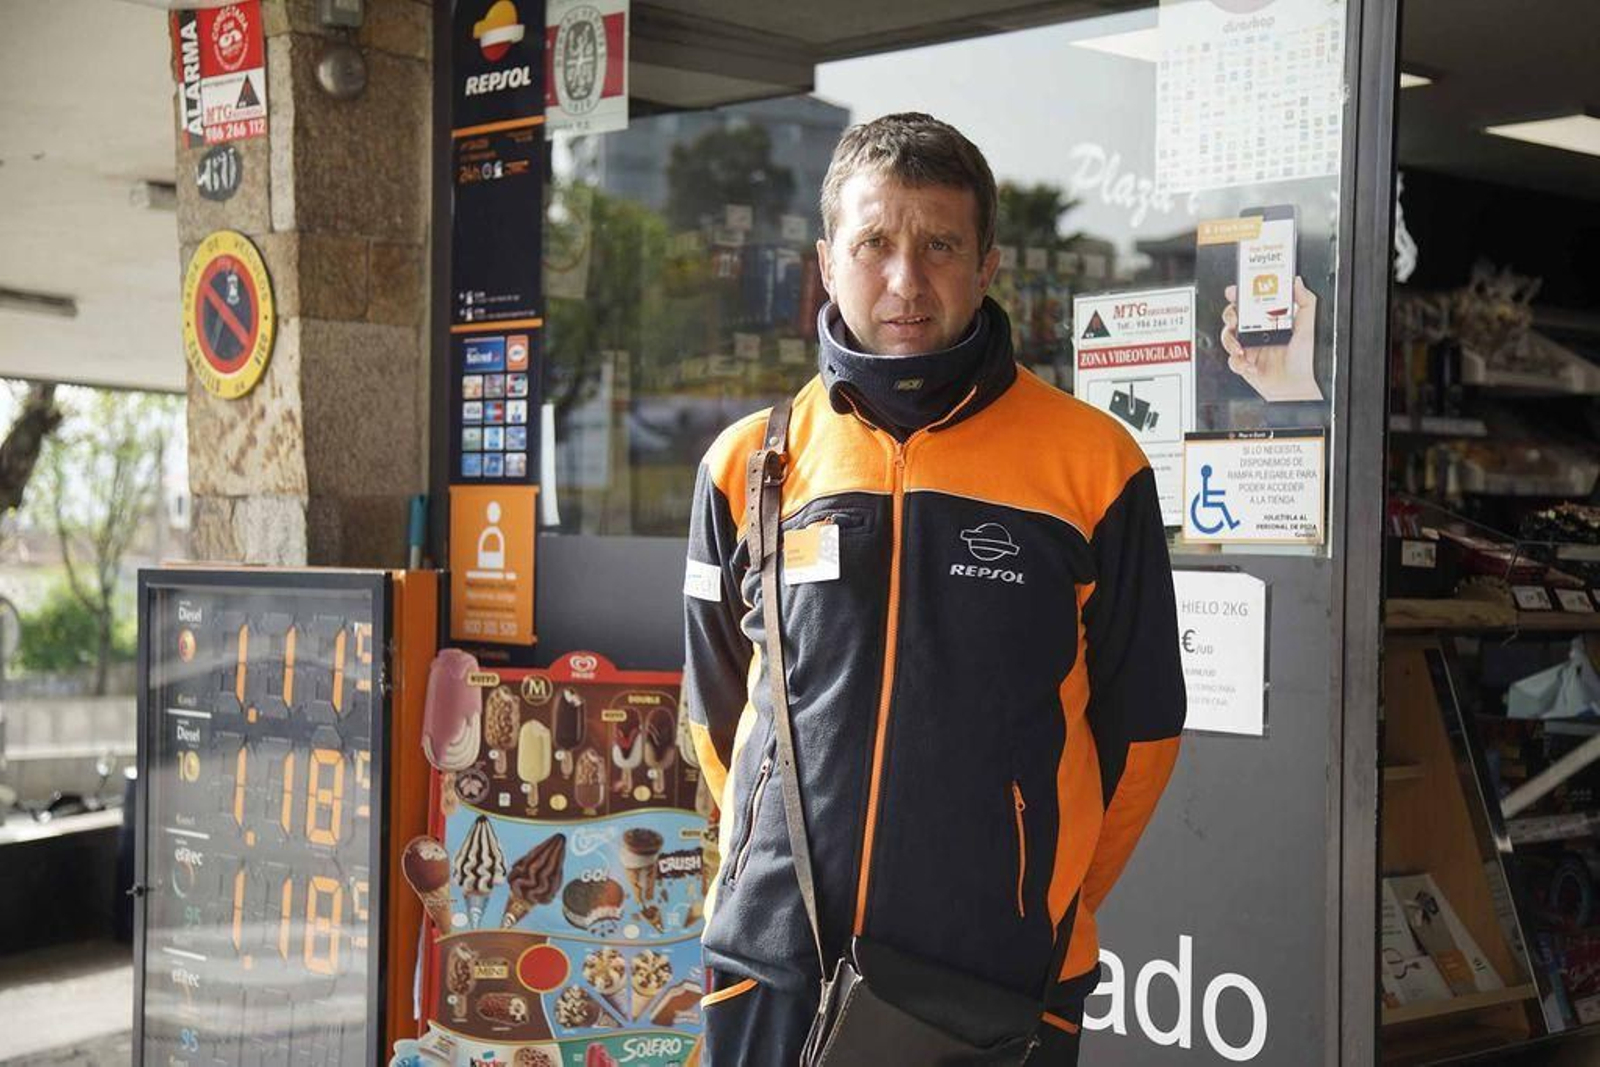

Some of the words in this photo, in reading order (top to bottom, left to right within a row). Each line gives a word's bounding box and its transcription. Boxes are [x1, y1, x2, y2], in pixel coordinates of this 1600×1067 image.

[180, 19, 204, 136] ALARMA
[465, 65, 532, 97] REPSOL
[1112, 302, 1148, 320] MTG
[1080, 350, 1108, 367] ZONA
[1108, 345, 1189, 365] VIDEOVIGILADA
[1264, 445, 1302, 454] NECESITA
[1240, 457, 1290, 467] DISPONEMOS
[1293, 457, 1303, 466] DE
[1296, 469, 1317, 478] PARA
[949, 563, 1025, 585] REPSOL
[1181, 598, 1219, 615] HIELO
[1222, 601, 1249, 617] 2KG
[658, 854, 701, 873] CRUSH
[620, 1037, 682, 1063] SOLERO
